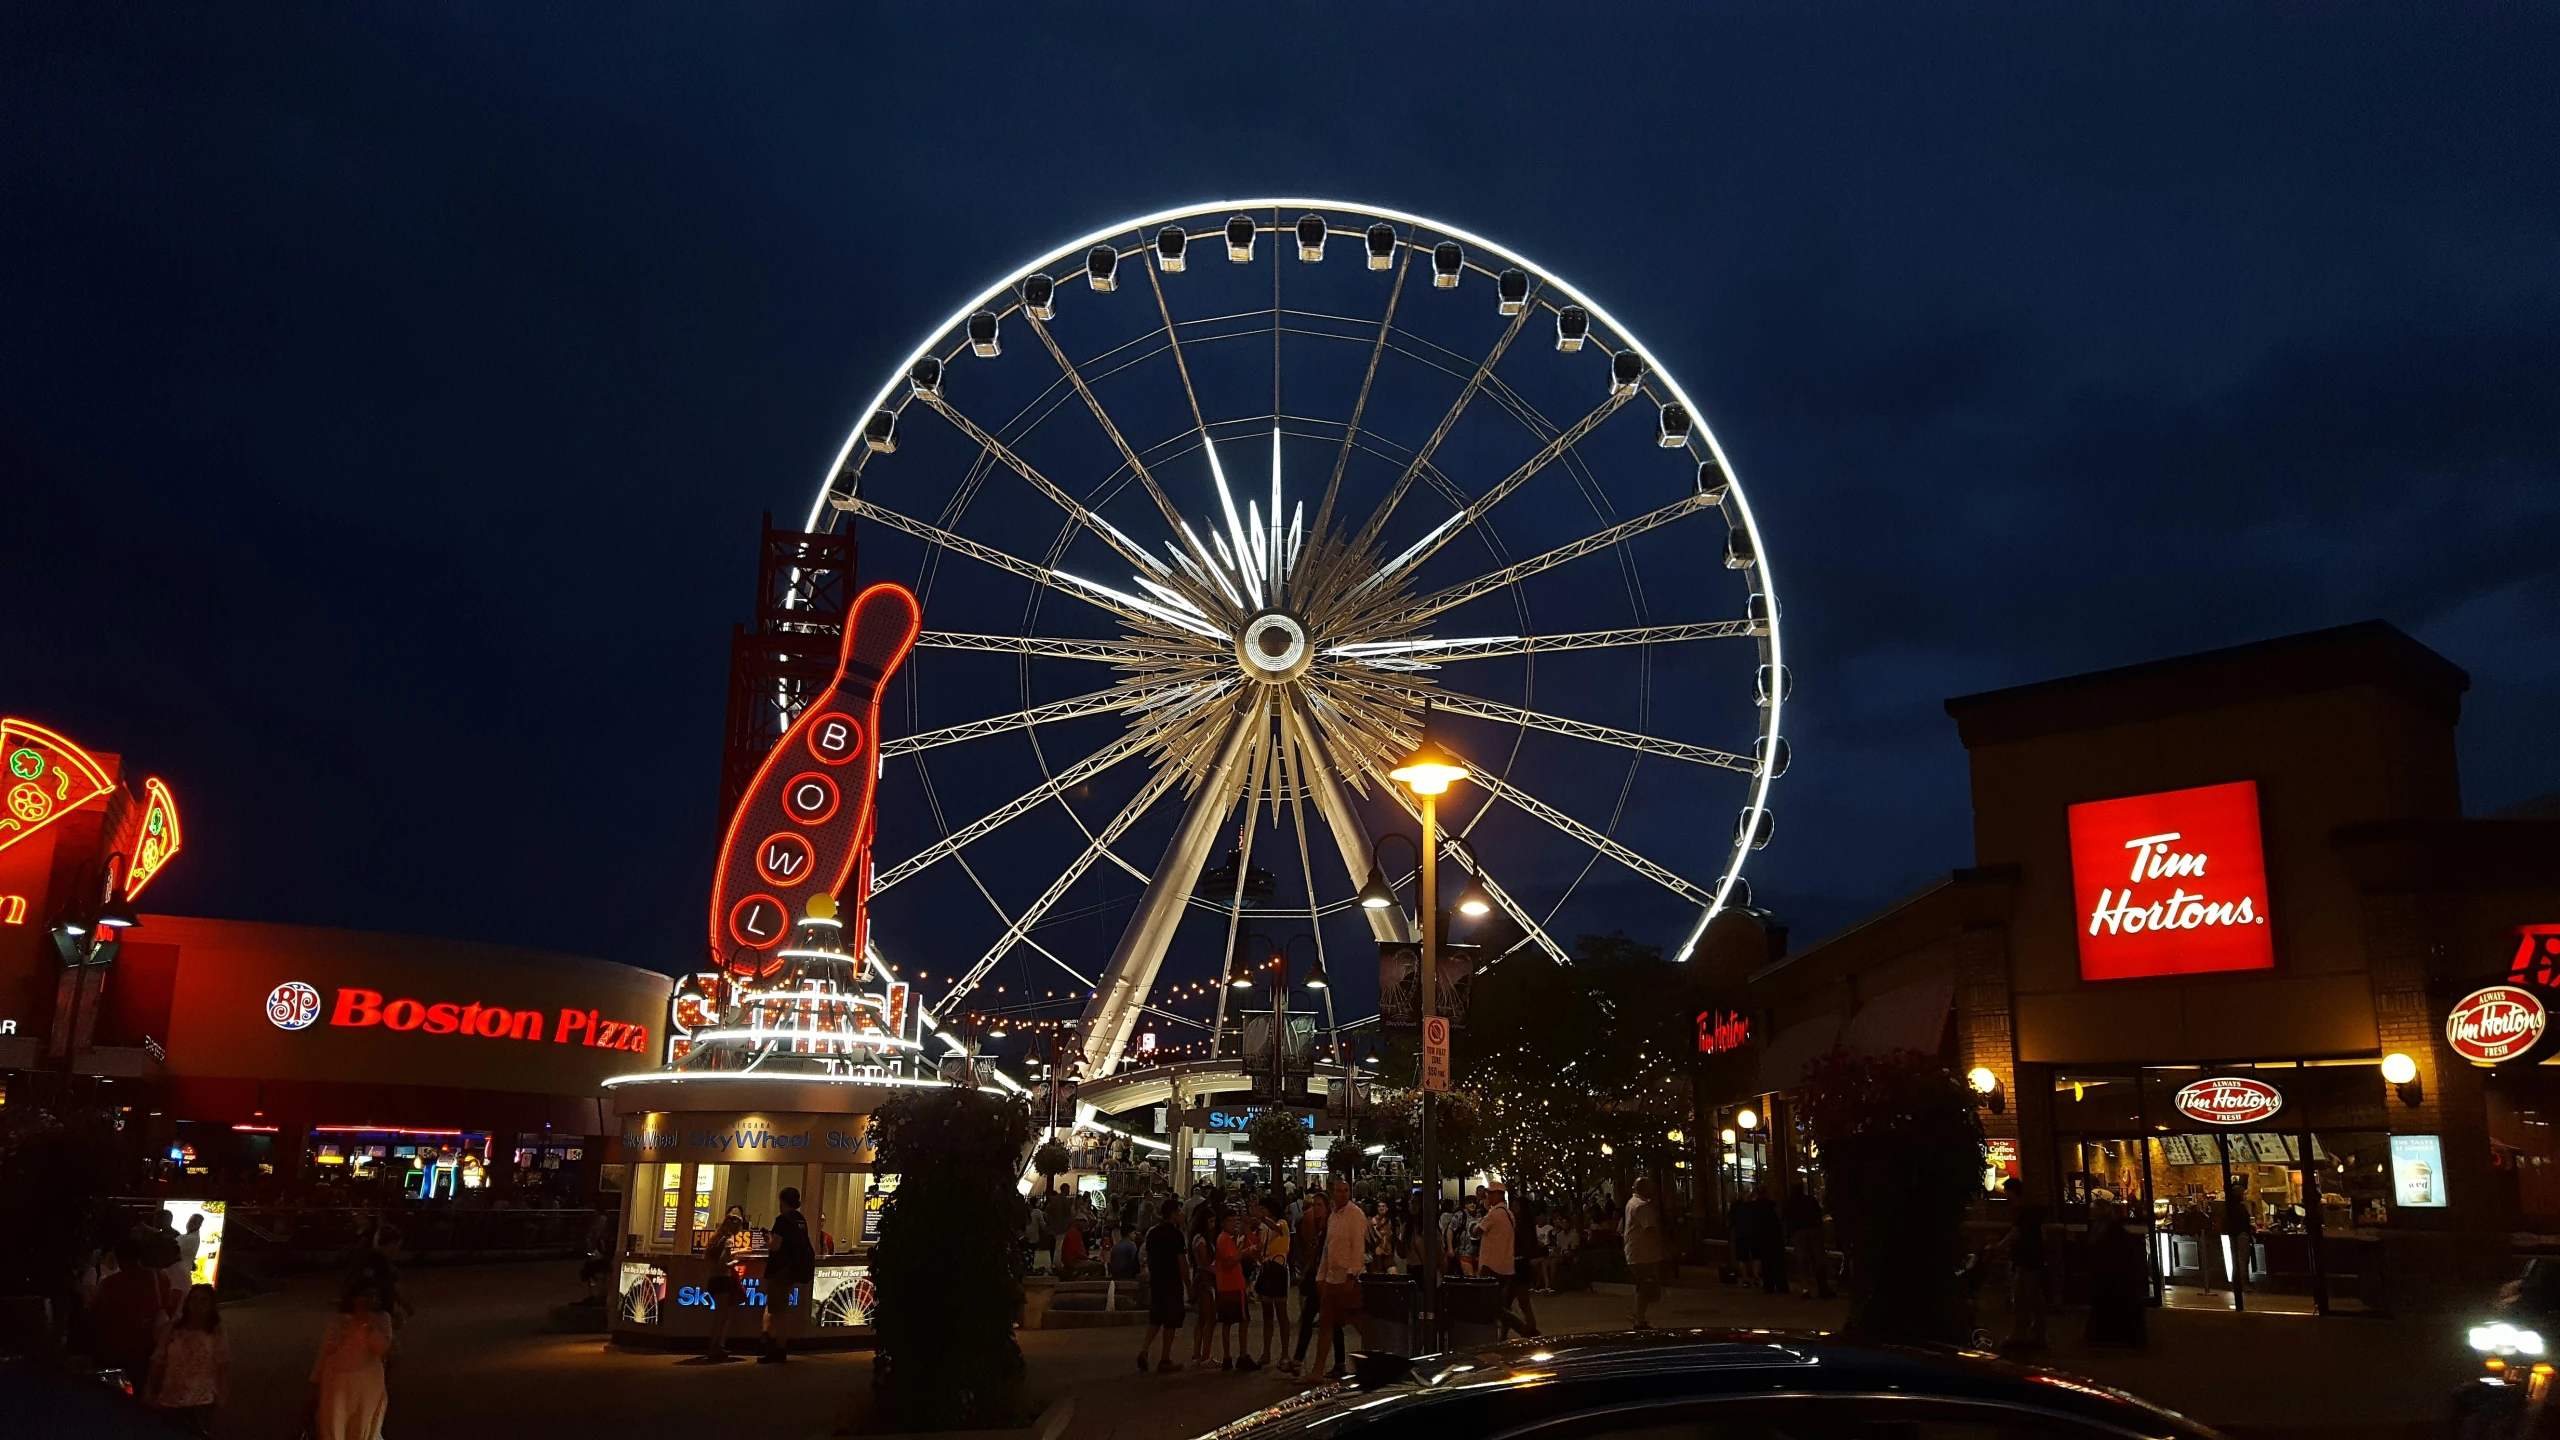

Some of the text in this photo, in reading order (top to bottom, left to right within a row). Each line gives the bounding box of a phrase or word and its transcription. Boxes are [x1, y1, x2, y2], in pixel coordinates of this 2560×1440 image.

[2125, 832, 2207, 883] Tim
[2089, 888, 2254, 936] Hortons
[2479, 991, 2506, 1004] ALWAYS
[330, 988, 542, 1041] Boston
[554, 1008, 649, 1053] Pizza
[2449, 1005, 2543, 1042] Tim Hortons
[1696, 1011, 1714, 1053] Tim
[2484, 1045, 2508, 1056] FRESH
[2178, 1088, 2279, 1109] Tim Hortons
[623, 1130, 679, 1151] SkyWheel
[691, 1130, 811, 1152] SkyWheel
[831, 1269, 842, 1278] Way
